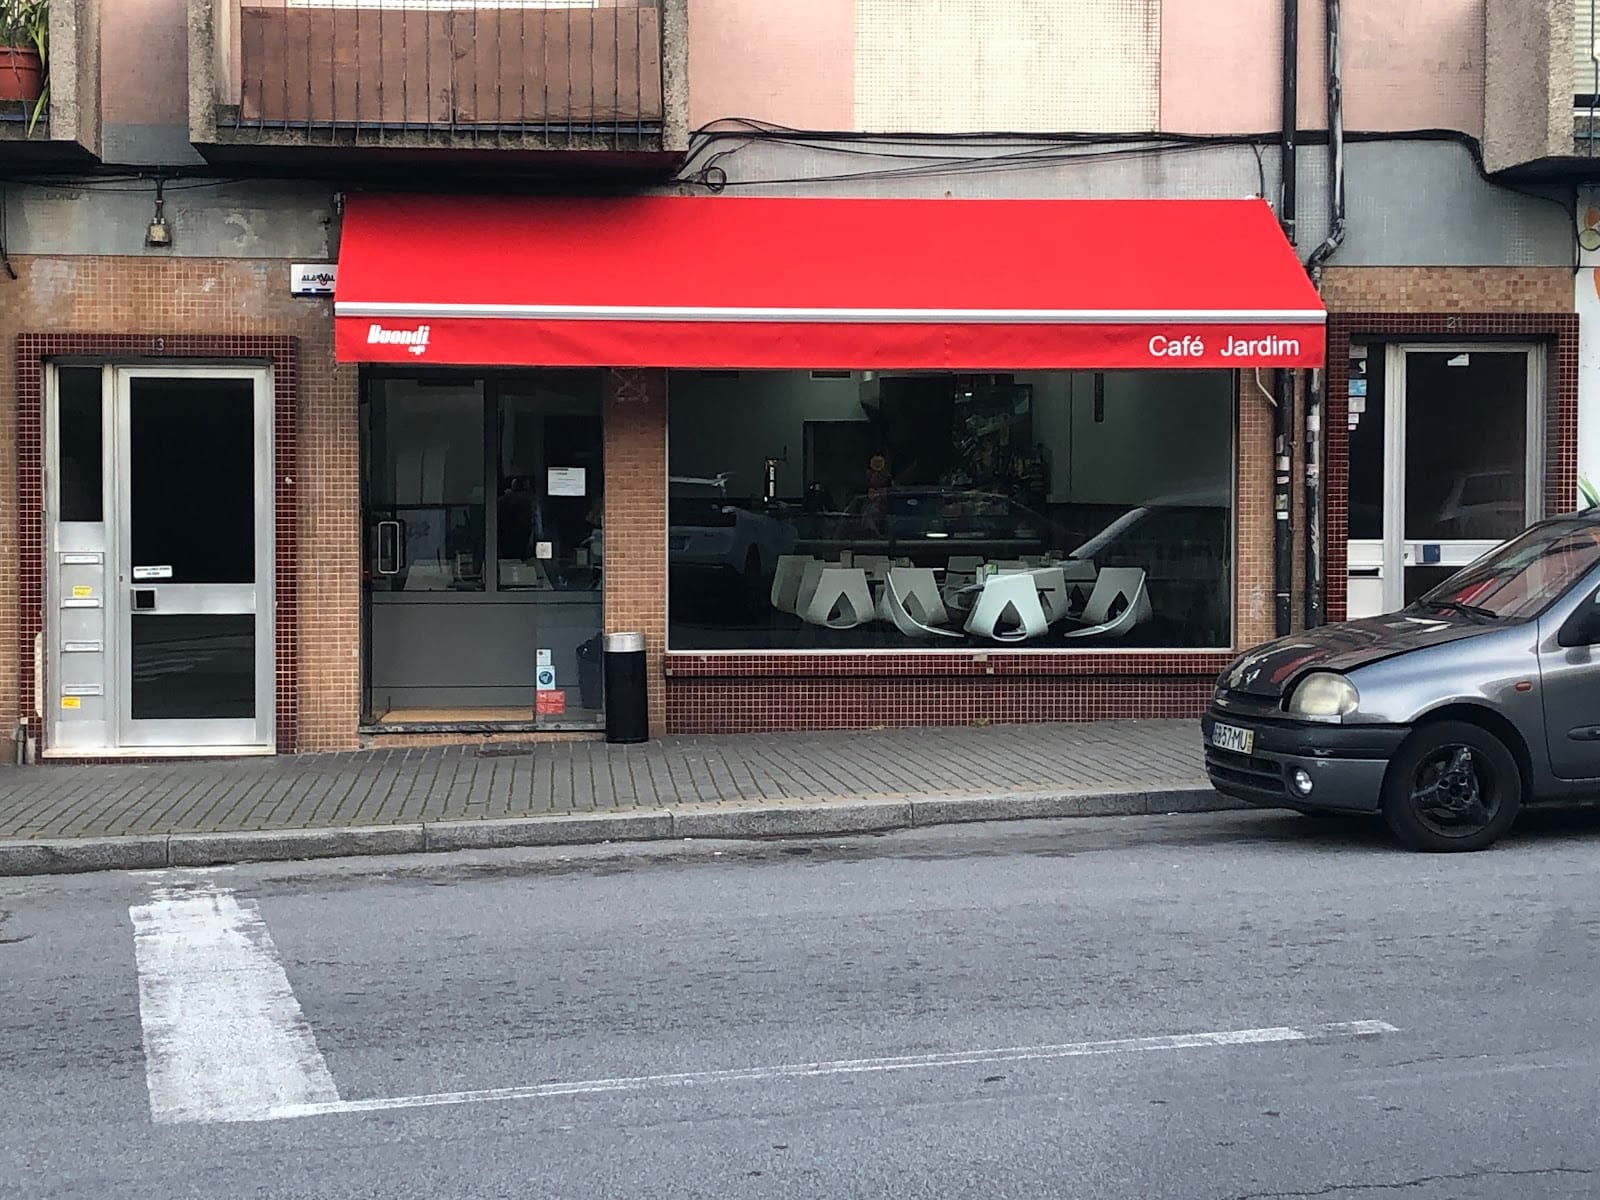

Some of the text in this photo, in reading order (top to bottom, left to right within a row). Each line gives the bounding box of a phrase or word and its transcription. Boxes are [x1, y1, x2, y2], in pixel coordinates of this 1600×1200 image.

[1447, 316, 1462, 329] 21
[367, 324, 430, 345] Buondi
[151, 337, 165, 351] 13
[1148, 335, 1300, 357] Café Jardim
